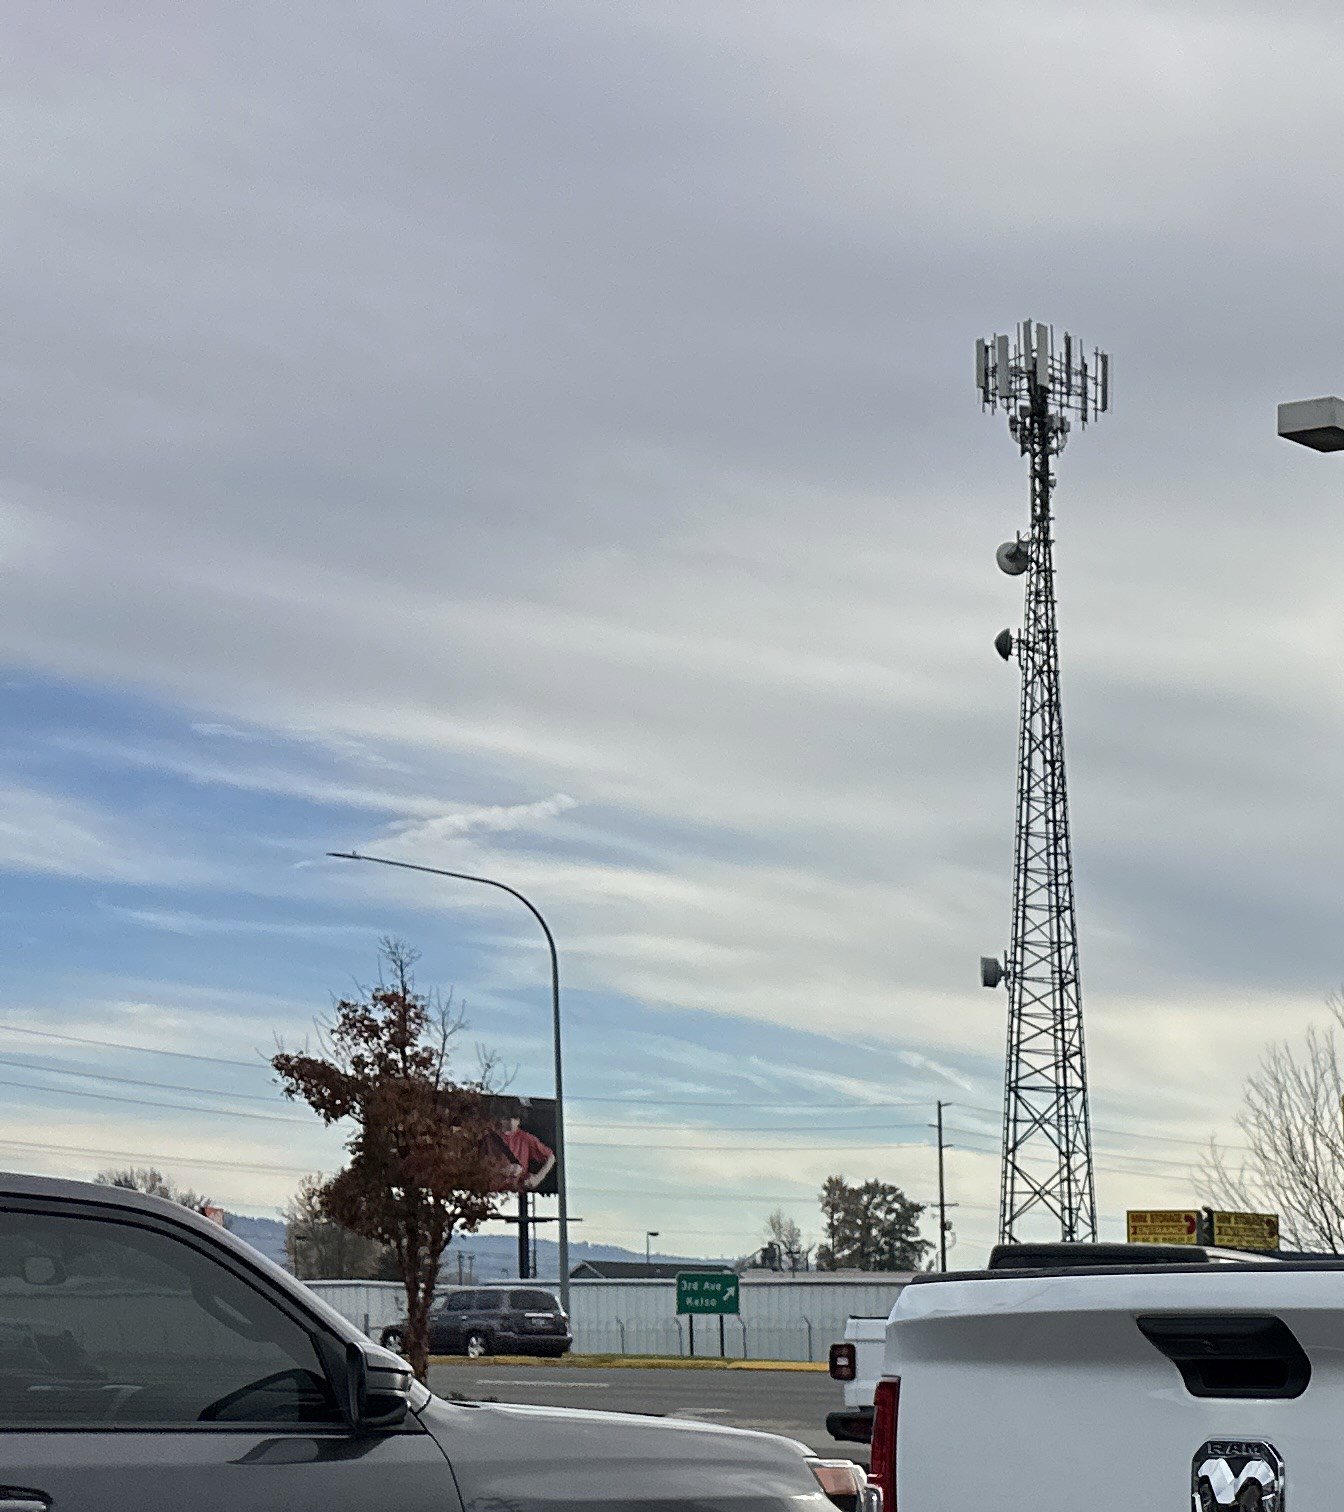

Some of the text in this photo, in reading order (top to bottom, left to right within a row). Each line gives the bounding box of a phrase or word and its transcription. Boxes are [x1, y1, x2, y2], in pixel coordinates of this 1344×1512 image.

[681, 1280, 721, 1291] 3rd Ave
[685, 1296, 717, 1307] Kelso
[1207, 1442, 1262, 1457] RAM
